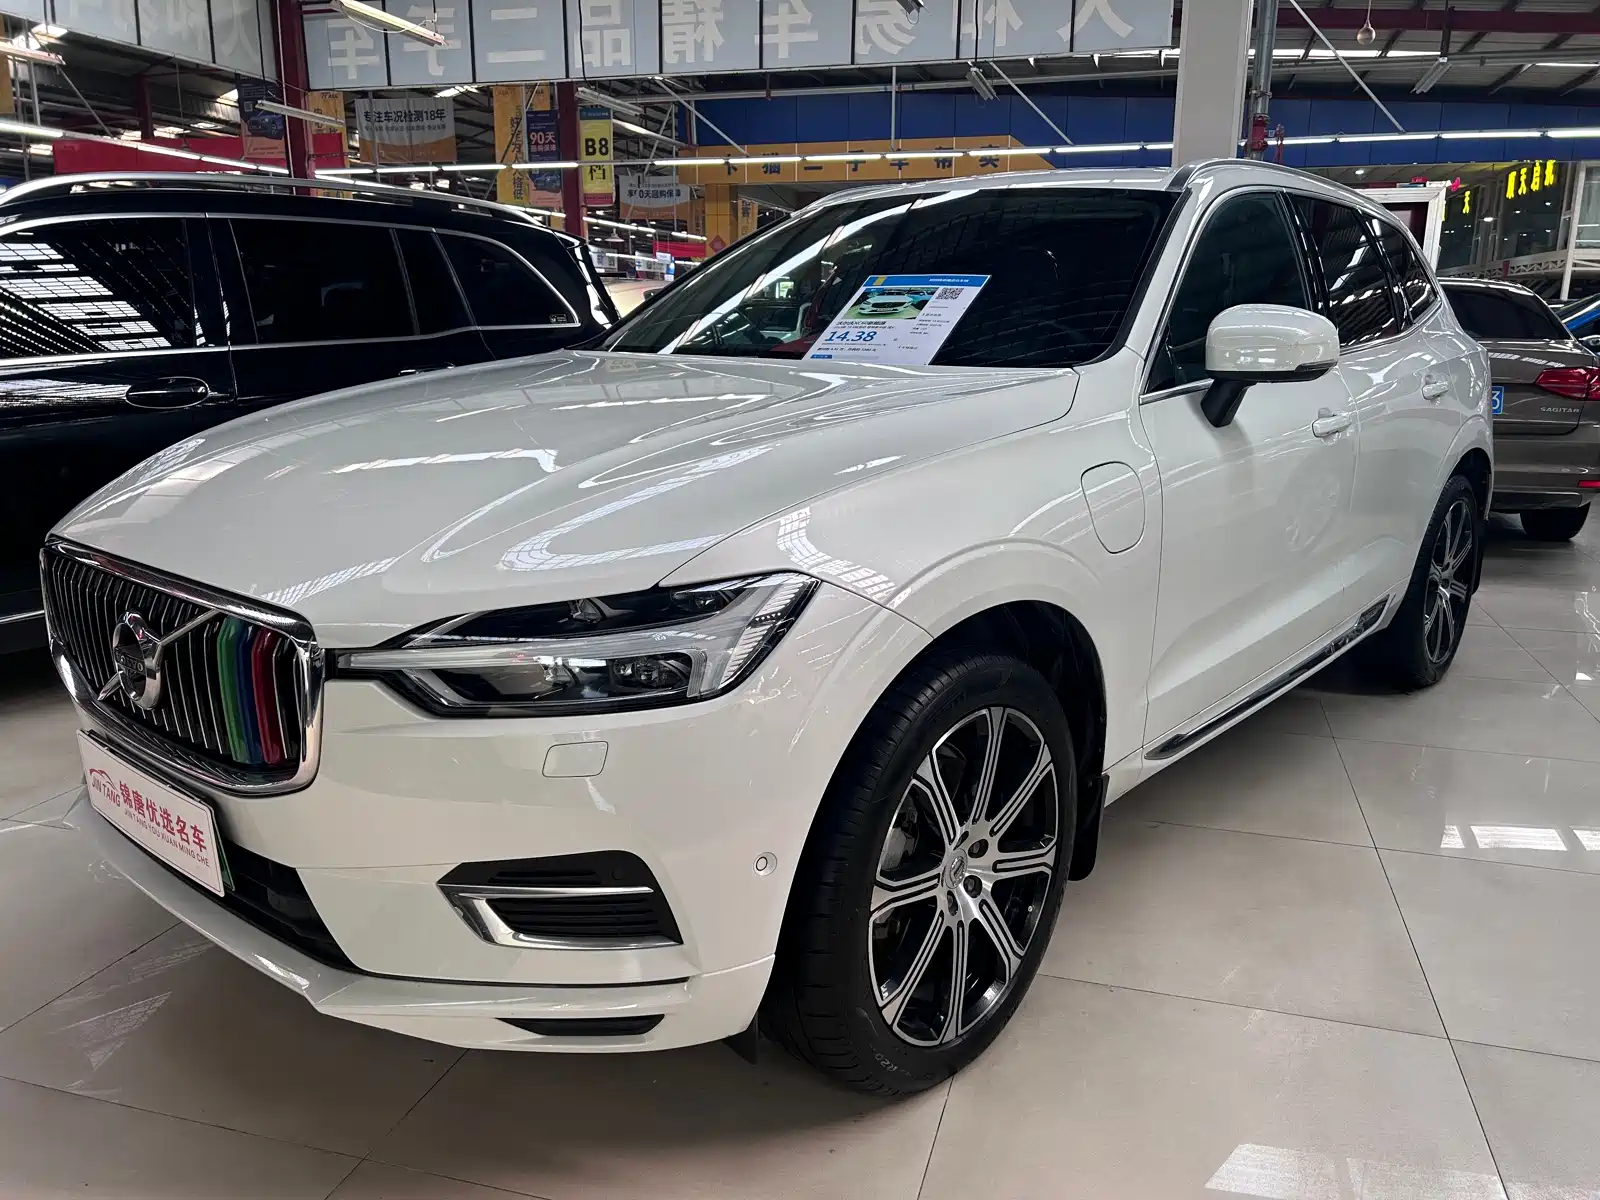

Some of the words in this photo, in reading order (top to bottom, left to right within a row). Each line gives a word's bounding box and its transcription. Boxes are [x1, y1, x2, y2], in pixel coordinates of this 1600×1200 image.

[364, 109, 446, 123] 专注车况检测18年
[530, 132, 556, 145] 90天
[585, 137, 609, 156] B8
[824, 330, 878, 342] 14.38
[91, 775, 102, 793] JIN
[102, 783, 121, 807] TANG
[119, 780, 207, 852] 锦唐优选名车
[179, 843, 196, 859] MING
[196, 853, 210, 867] CHE
